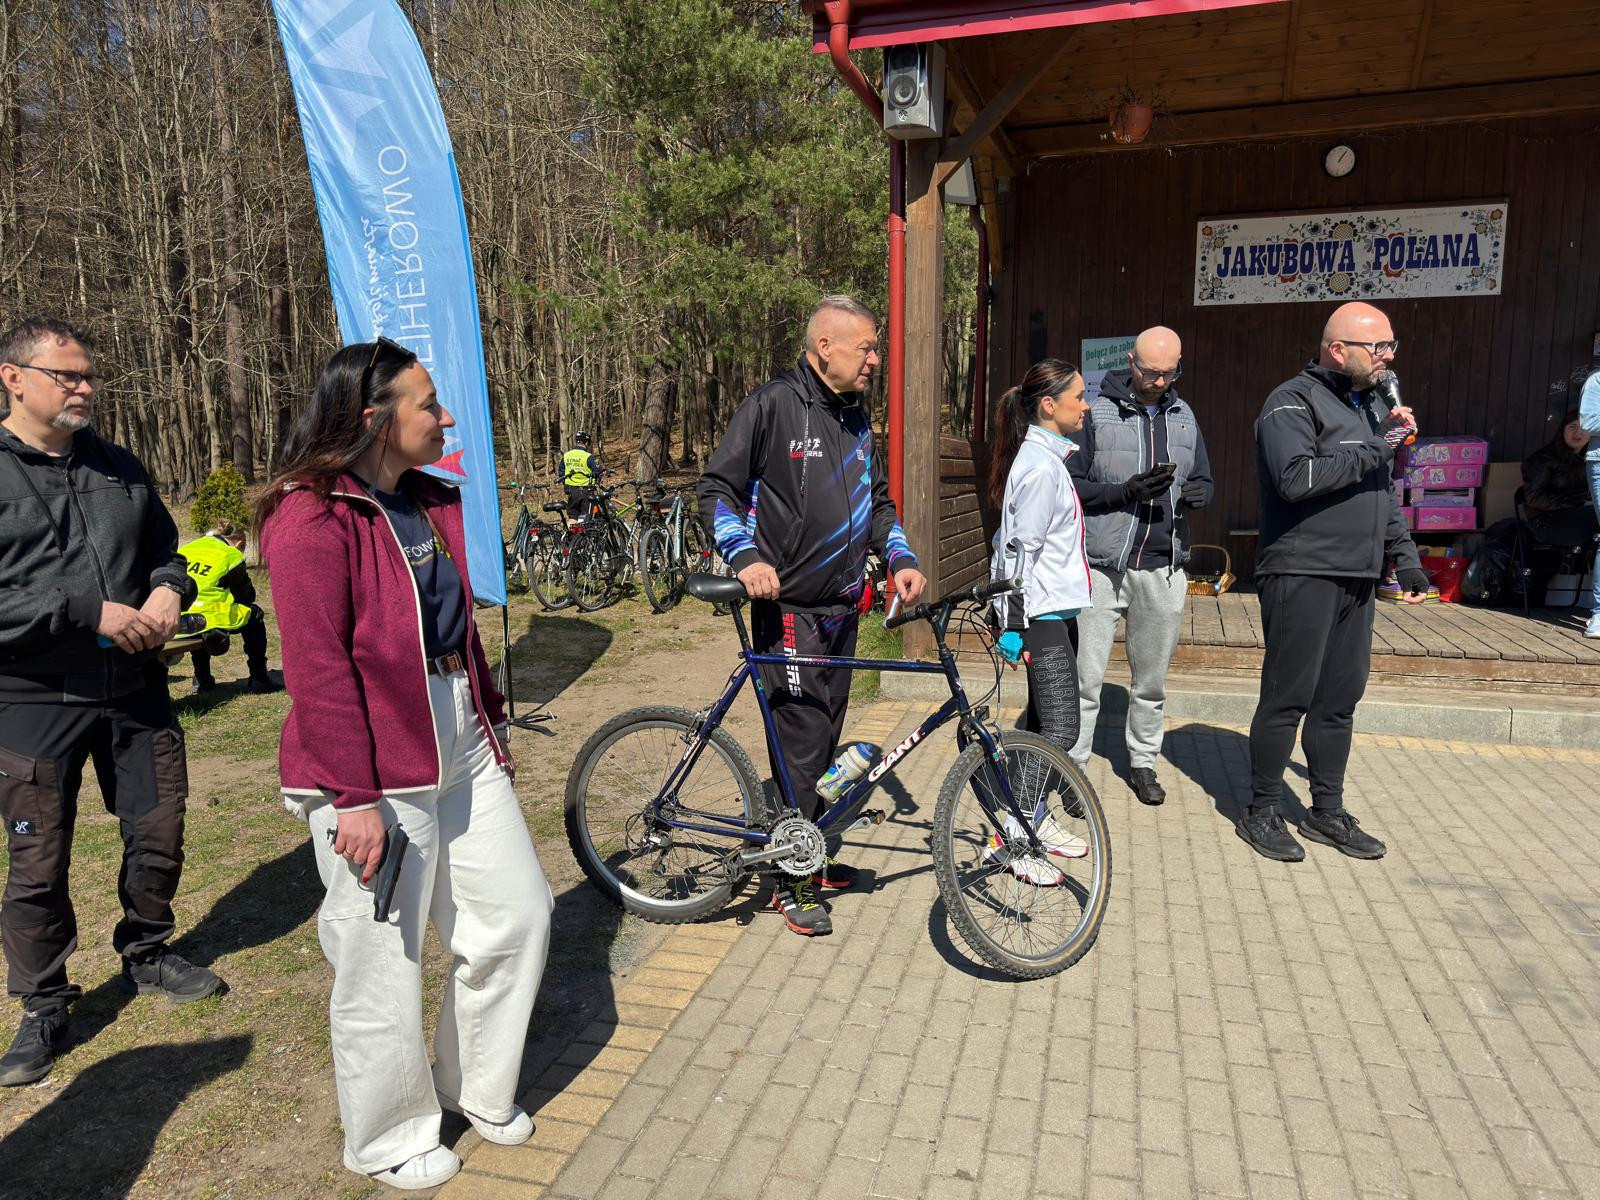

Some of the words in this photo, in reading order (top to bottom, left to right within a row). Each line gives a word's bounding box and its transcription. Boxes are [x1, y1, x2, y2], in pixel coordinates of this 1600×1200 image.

[1216, 239, 1356, 278] JAKUBOWA
[1371, 232, 1480, 271] POLANA
[1109, 344, 1117, 355] do
[868, 727, 923, 782] GIANT
